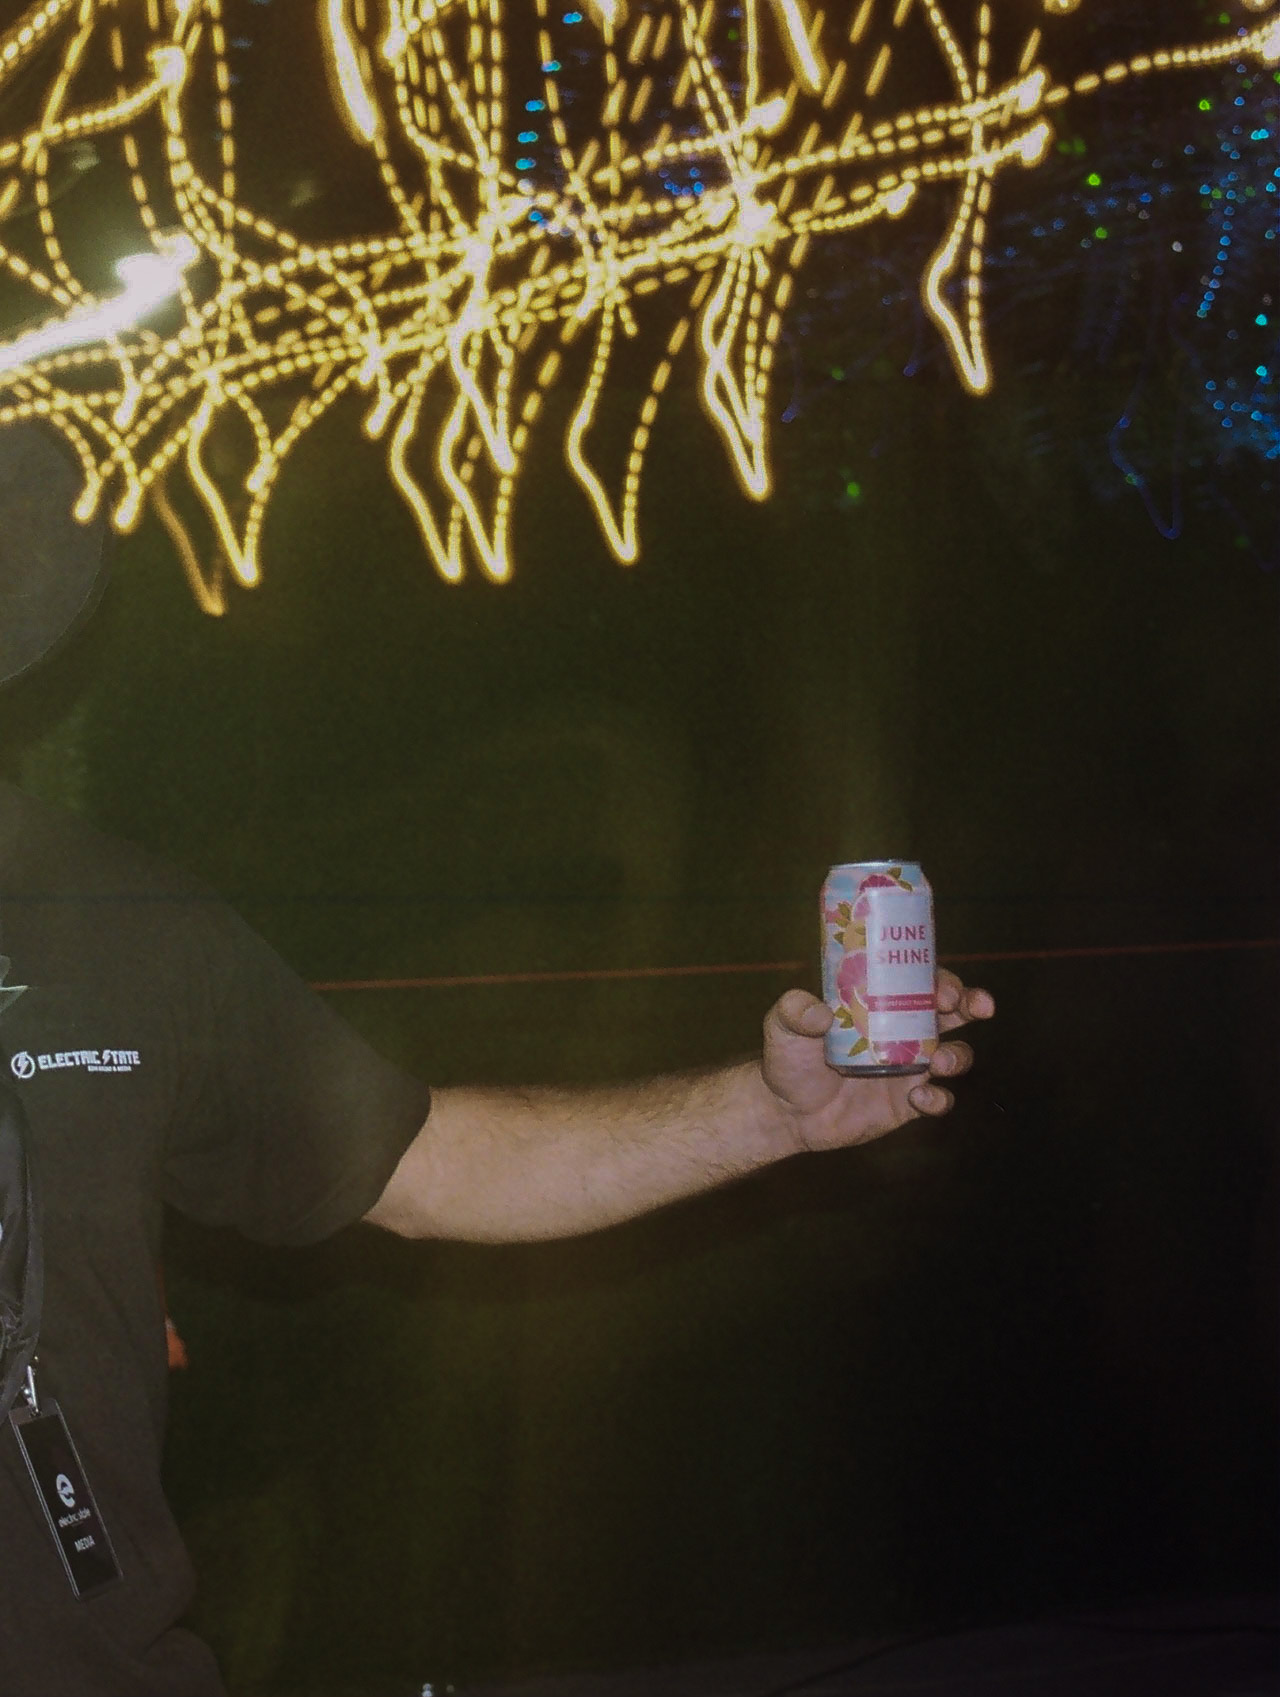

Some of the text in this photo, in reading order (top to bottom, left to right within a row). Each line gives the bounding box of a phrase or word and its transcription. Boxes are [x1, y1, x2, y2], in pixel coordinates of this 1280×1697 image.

[880, 924, 926, 942] JUNE
[37, 1050, 101, 1071] ELECTRIC
[74, 1535, 96, 1553] MEDIA
